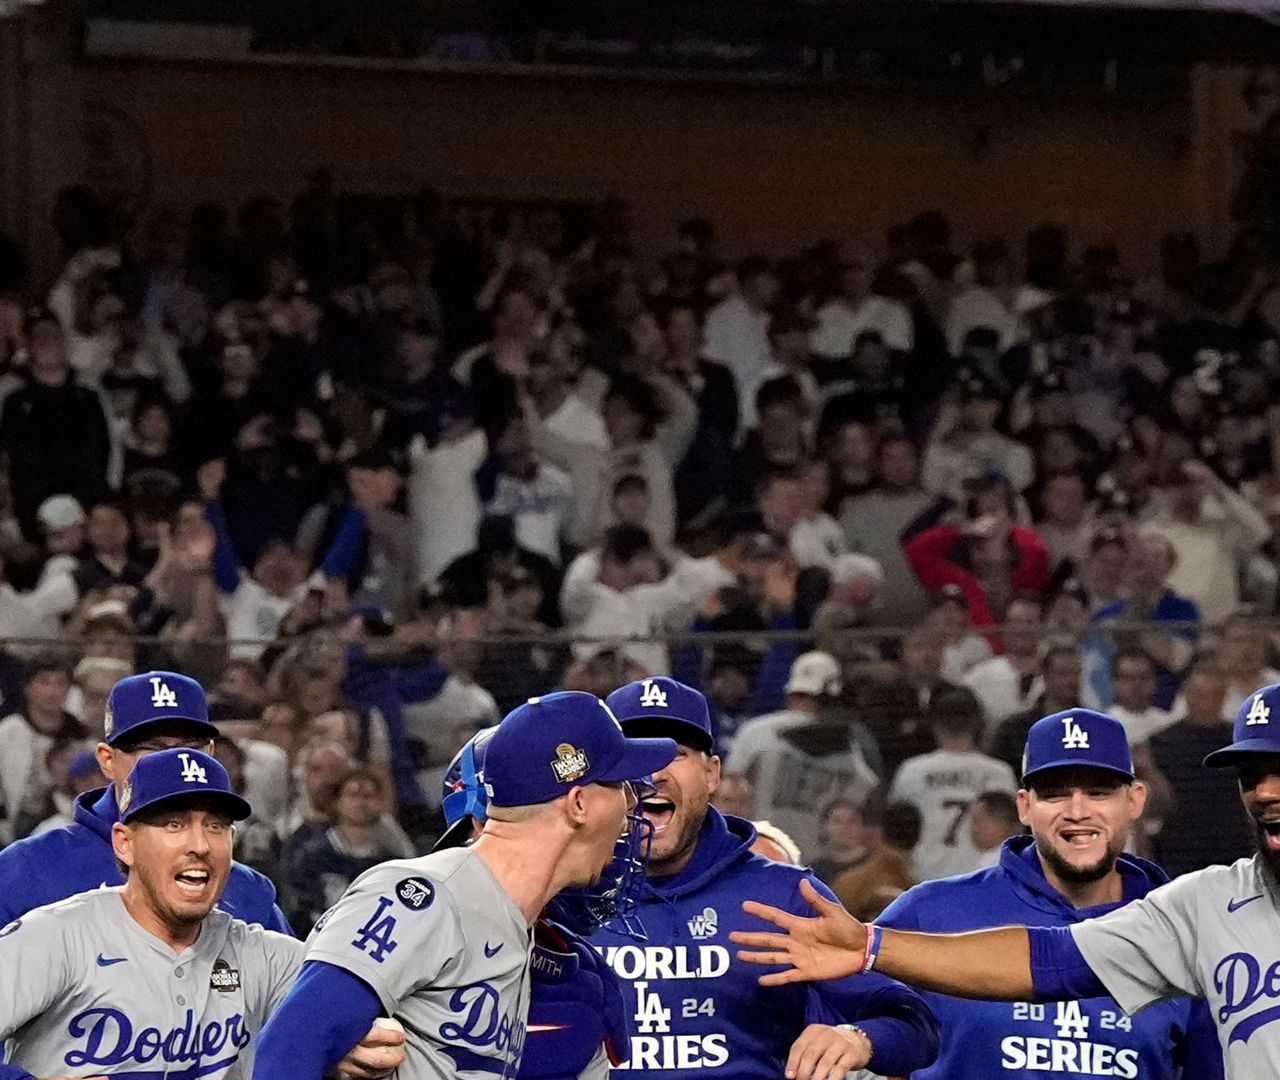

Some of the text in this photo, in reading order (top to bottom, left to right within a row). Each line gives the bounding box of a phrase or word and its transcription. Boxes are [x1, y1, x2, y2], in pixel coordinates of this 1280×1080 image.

[150, 678, 178, 707] LA
[640, 680, 668, 708] LA
[1246, 694, 1270, 725] LA
[1061, 717, 1090, 749] LA
[177, 753, 208, 783] LA
[942, 800, 968, 848] 7
[400, 883, 426, 907] 34
[351, 896, 398, 963] LA
[687, 921, 718, 937] WS
[530, 952, 563, 978] MITH
[634, 981, 715, 1033] LA 24
[1013, 1000, 1132, 1039] 20 LA 24
[608, 1034, 729, 1070] RIES
[1001, 1036, 1139, 1079] SERIES
